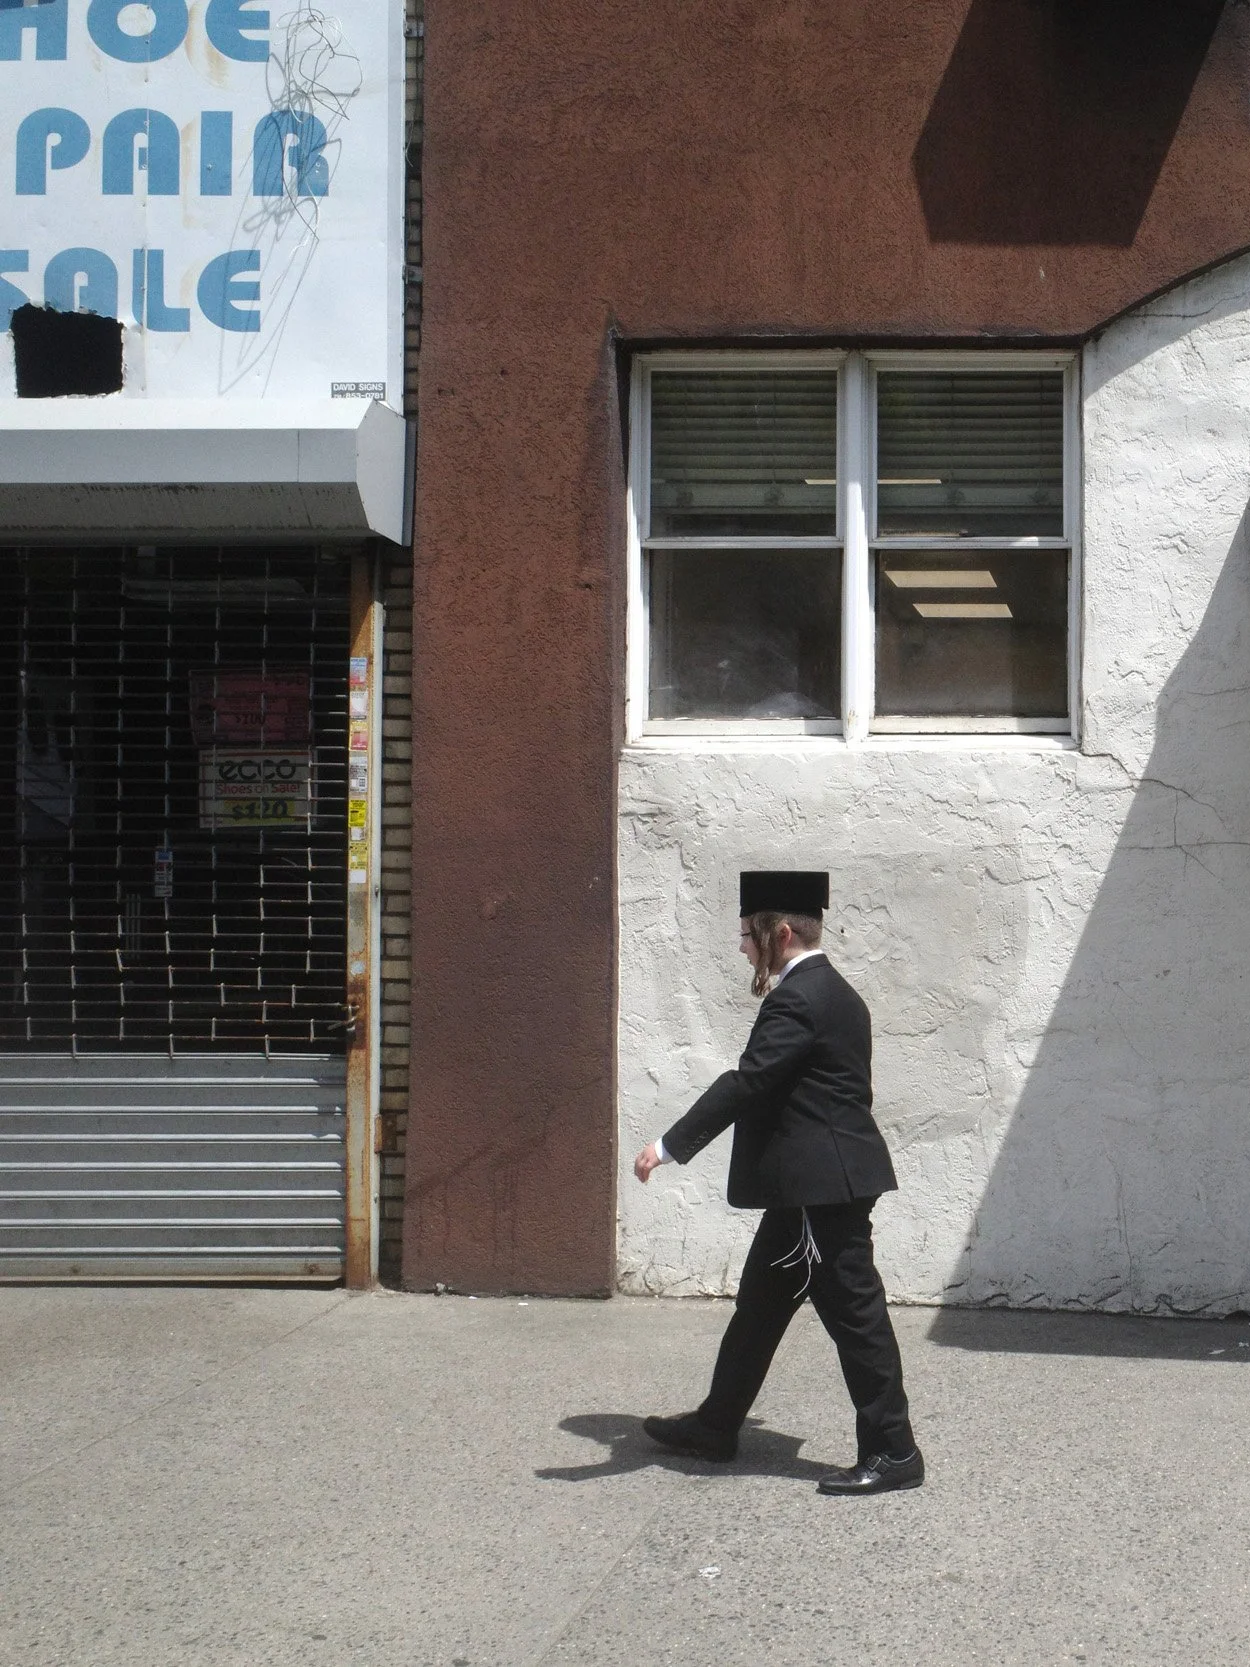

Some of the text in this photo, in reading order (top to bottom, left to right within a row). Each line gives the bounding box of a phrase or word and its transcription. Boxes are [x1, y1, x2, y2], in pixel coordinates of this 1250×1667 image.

[16, 107, 330, 197] PAIR
[333, 383, 384, 391] DAVID SIGNS
[219, 759, 296, 780] ecco
[216, 783, 252, 795] Shoes
